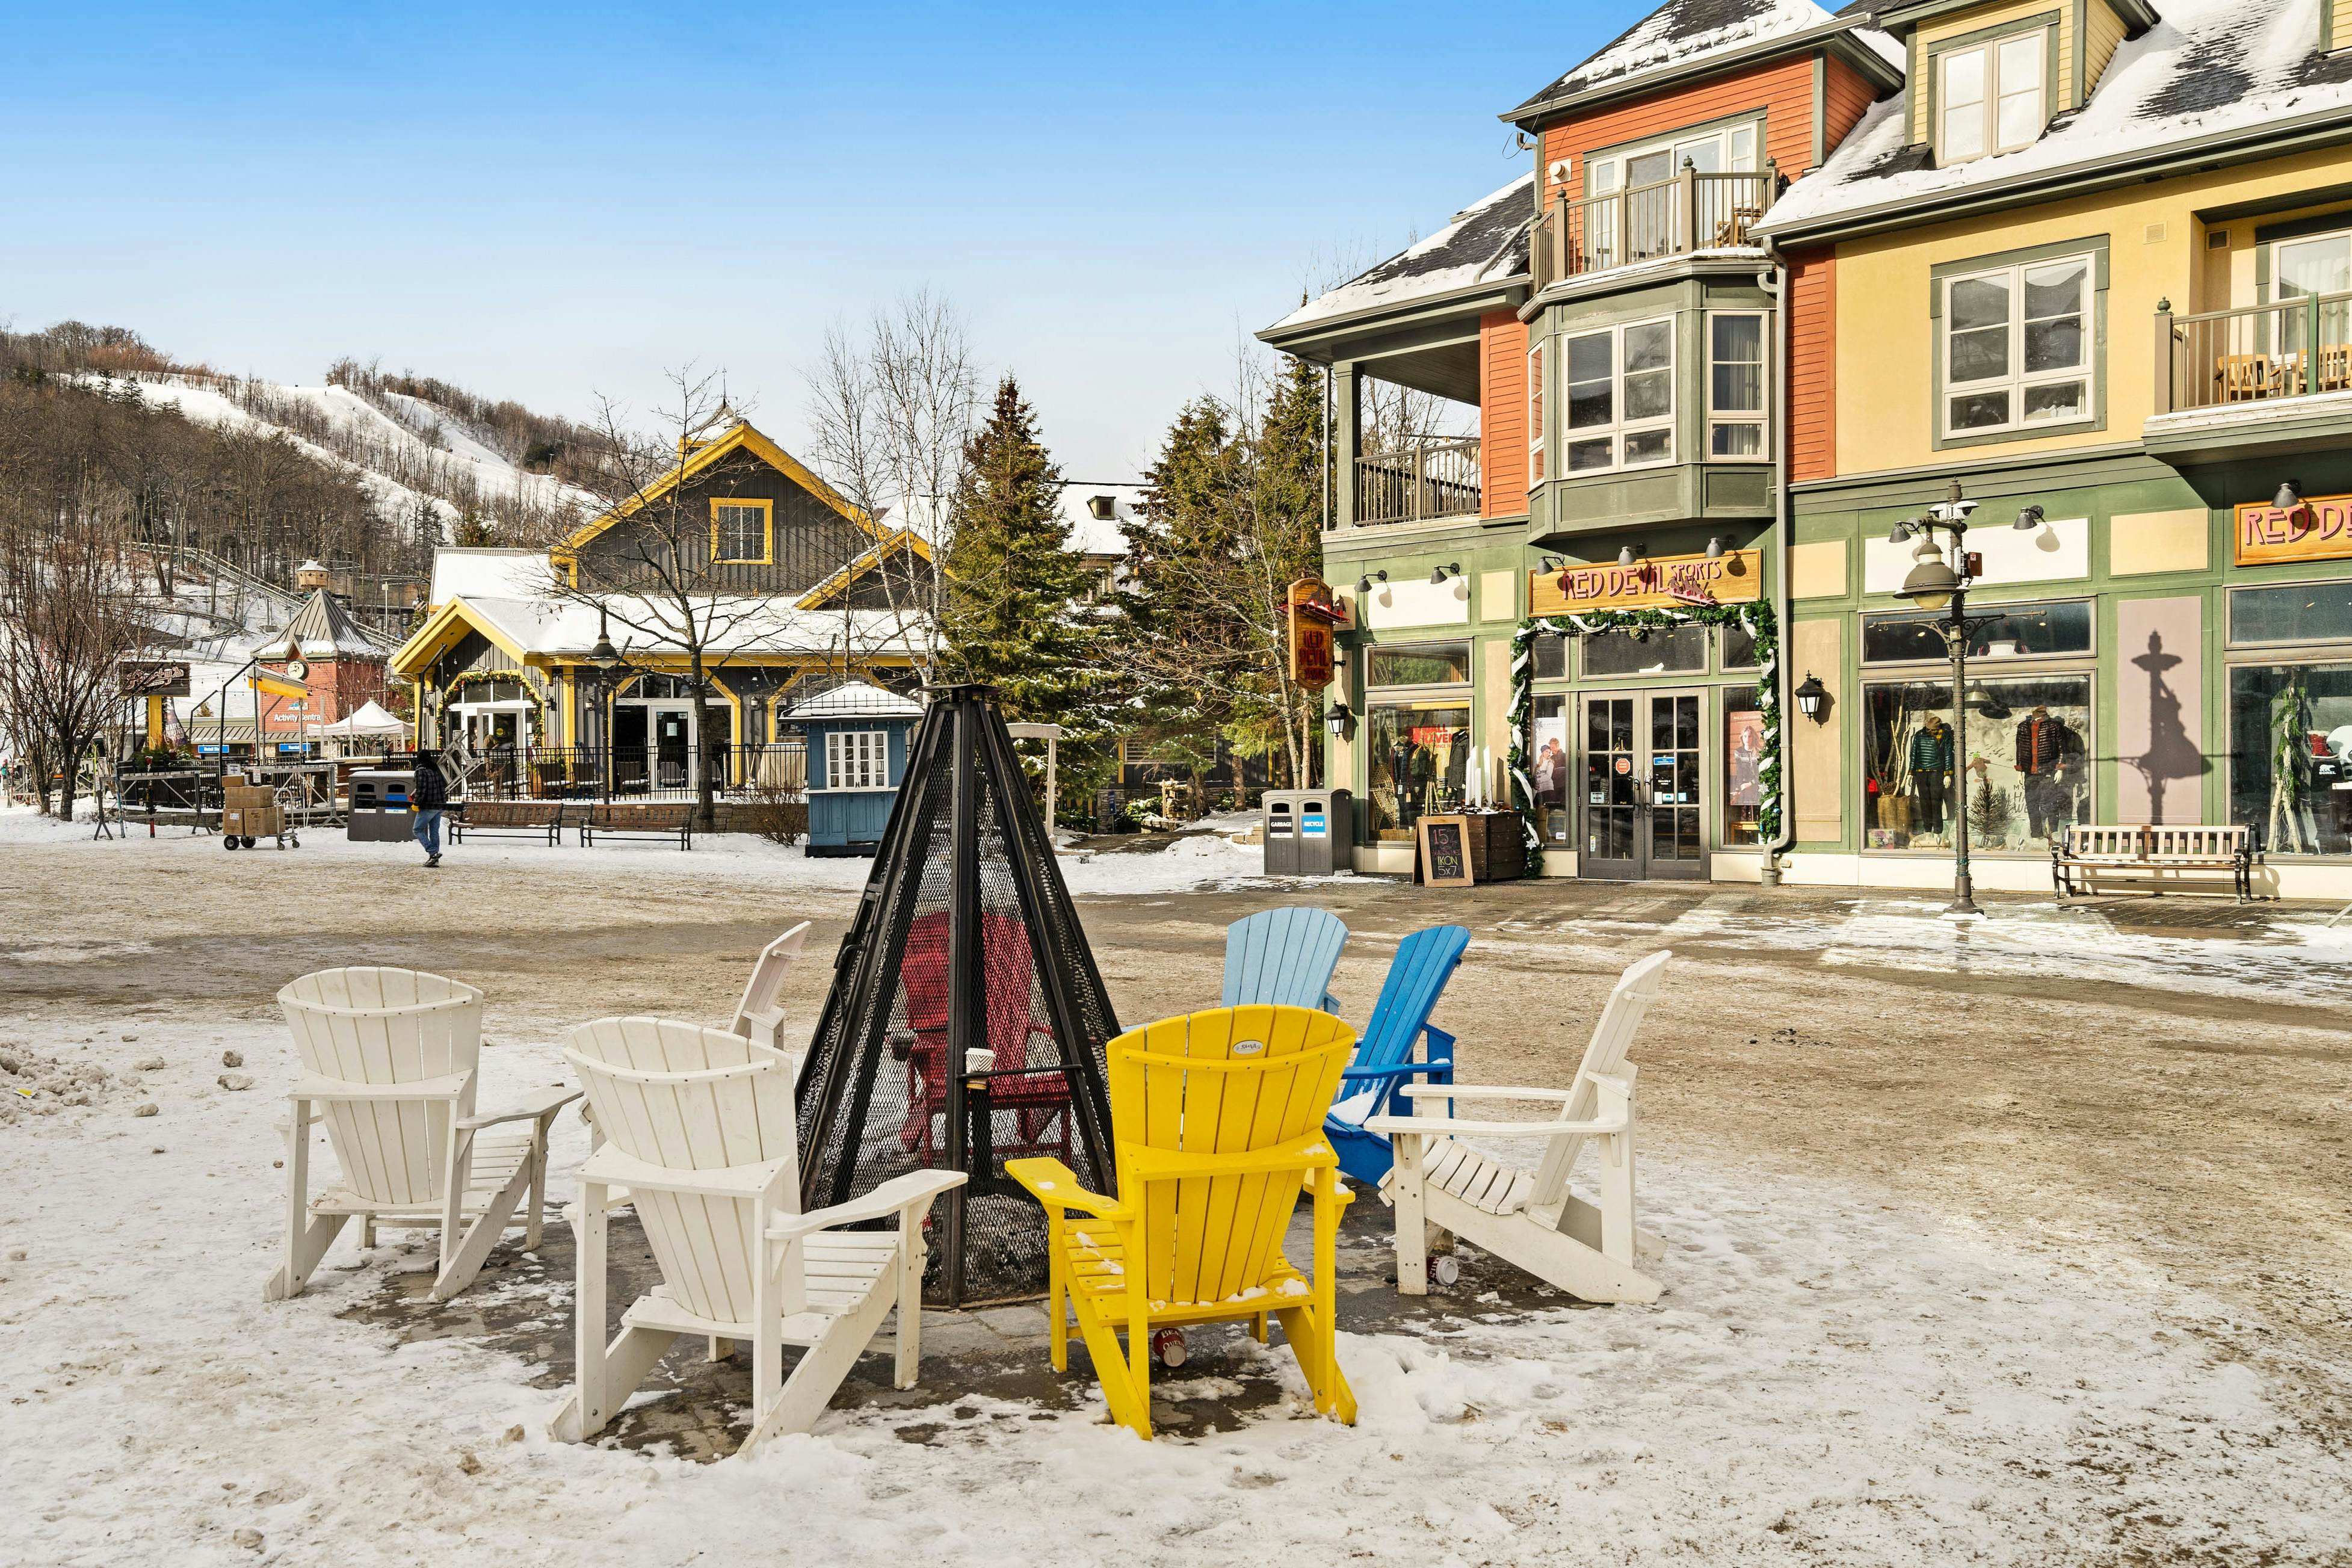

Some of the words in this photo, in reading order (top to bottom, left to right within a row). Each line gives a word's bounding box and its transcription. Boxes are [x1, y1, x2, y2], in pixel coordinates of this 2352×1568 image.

[2246, 504, 2312, 546] RED
[1563, 570, 1605, 600] RED
[1608, 563, 1666, 597] DEVIL
[1670, 561, 1722, 581] SPORTS
[1304, 630, 1324, 648] RED
[1299, 647, 1328, 666] DEVIL
[274, 714, 298, 723] Activity
[1437, 855, 1458, 866] IKON
[1438, 865, 1457, 876] 5x7
